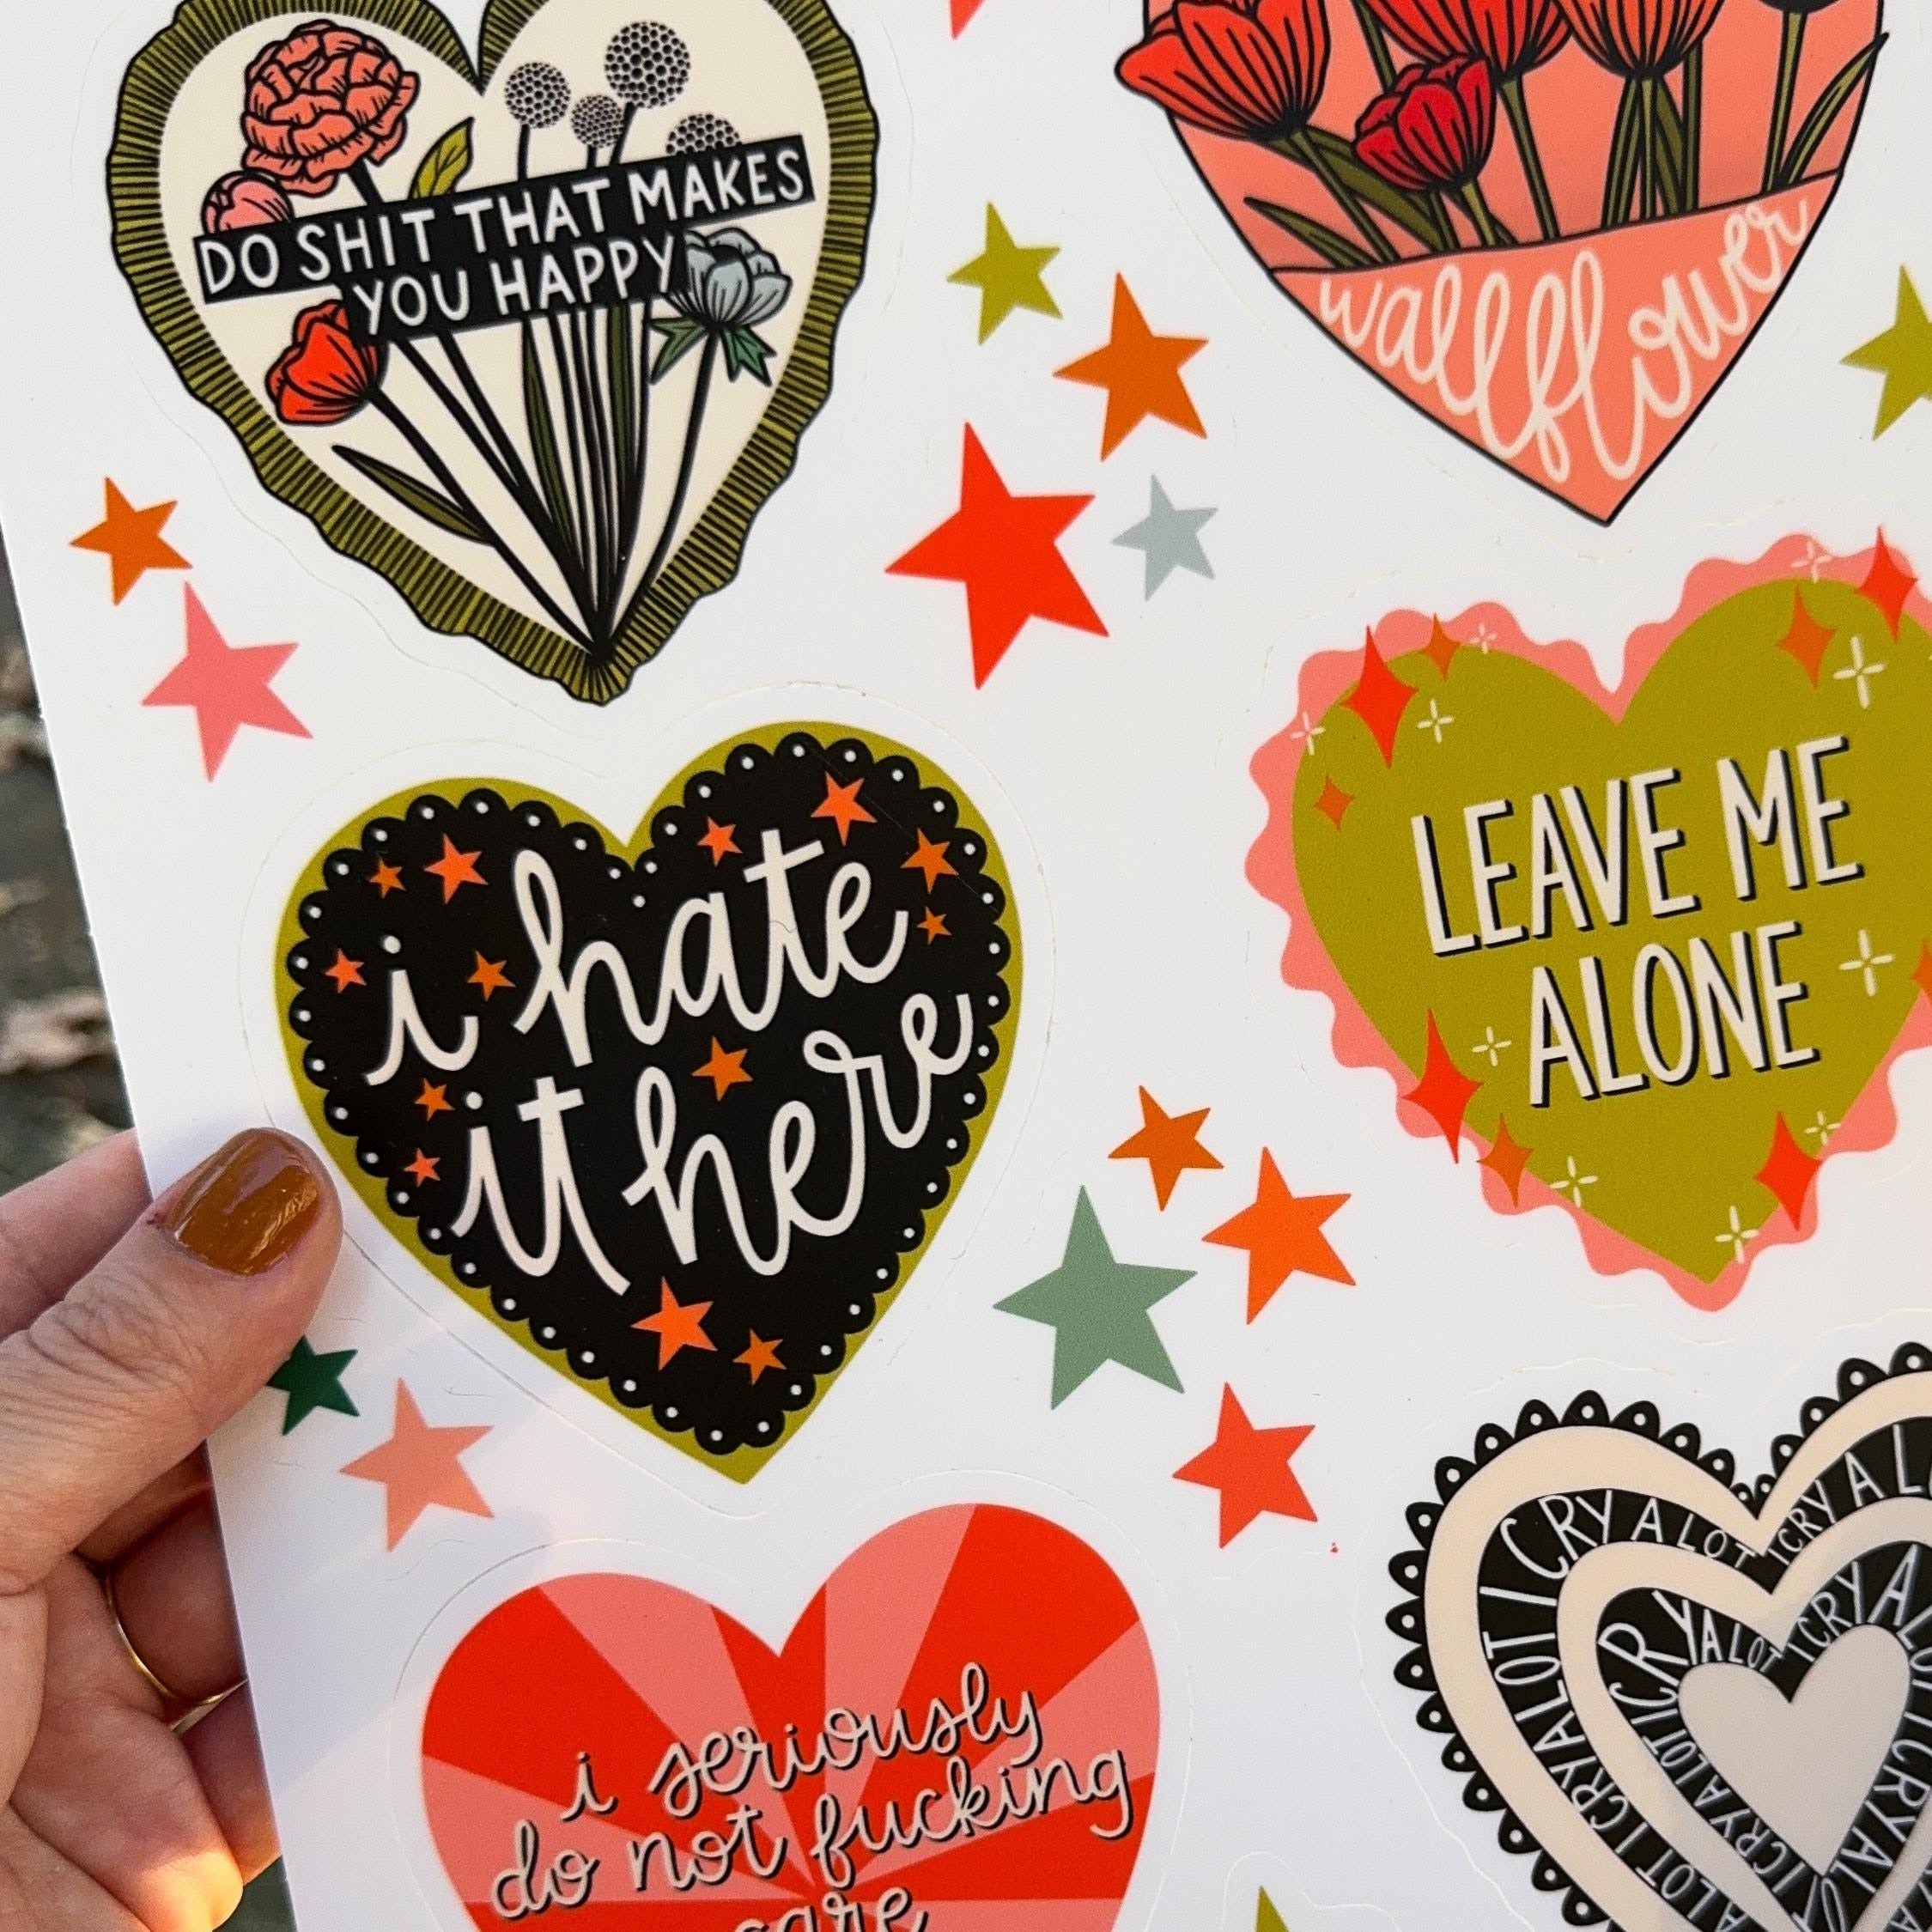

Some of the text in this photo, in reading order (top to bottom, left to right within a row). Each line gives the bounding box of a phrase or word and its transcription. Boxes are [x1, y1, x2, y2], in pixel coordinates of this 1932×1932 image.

[198, 149, 805, 294] DO SHIT THAT MAKES
[353, 229, 674, 334] YOU HAPPY
[1318, 201, 1808, 483] wallflower
[1410, 735, 1864, 957] LEAVE ME
[364, 829, 909, 1085] i hate
[1529, 920, 1820, 1108] ALONE
[451, 993, 974, 1297] it here
[1501, 1490, 1613, 1579] CRY
[1631, 1497, 1663, 1543] A
[1677, 1513, 1756, 1568] LOT
[1777, 1479, 1838, 1552] CRY
[1844, 1451, 1885, 1507] A
[1479, 1586, 1557, 1607] I
[1701, 1608, 1722, 1664] A
[1797, 1561, 1863, 1648] CRY
[1867, 1544, 1917, 1627] A
[1483, 1631, 1568, 1722] LOT
[1598, 1589, 1698, 1707] CRY
[1728, 1623, 1783, 1673] LOT
[561, 1662, 1044, 1823] i seriously
[1533, 1710, 1586, 1752] A
[1642, 1729, 1710, 1786] LOT
[492, 1749, 1134, 1921] do not fucking
[1549, 1756, 1628, 1831] CRY
[1693, 1774, 1732, 1807] A
[1635, 1849, 1717, 1921] LOT
[1710, 1807, 1787, 1874] CRY
[1839, 1826, 1893, 1867] A
